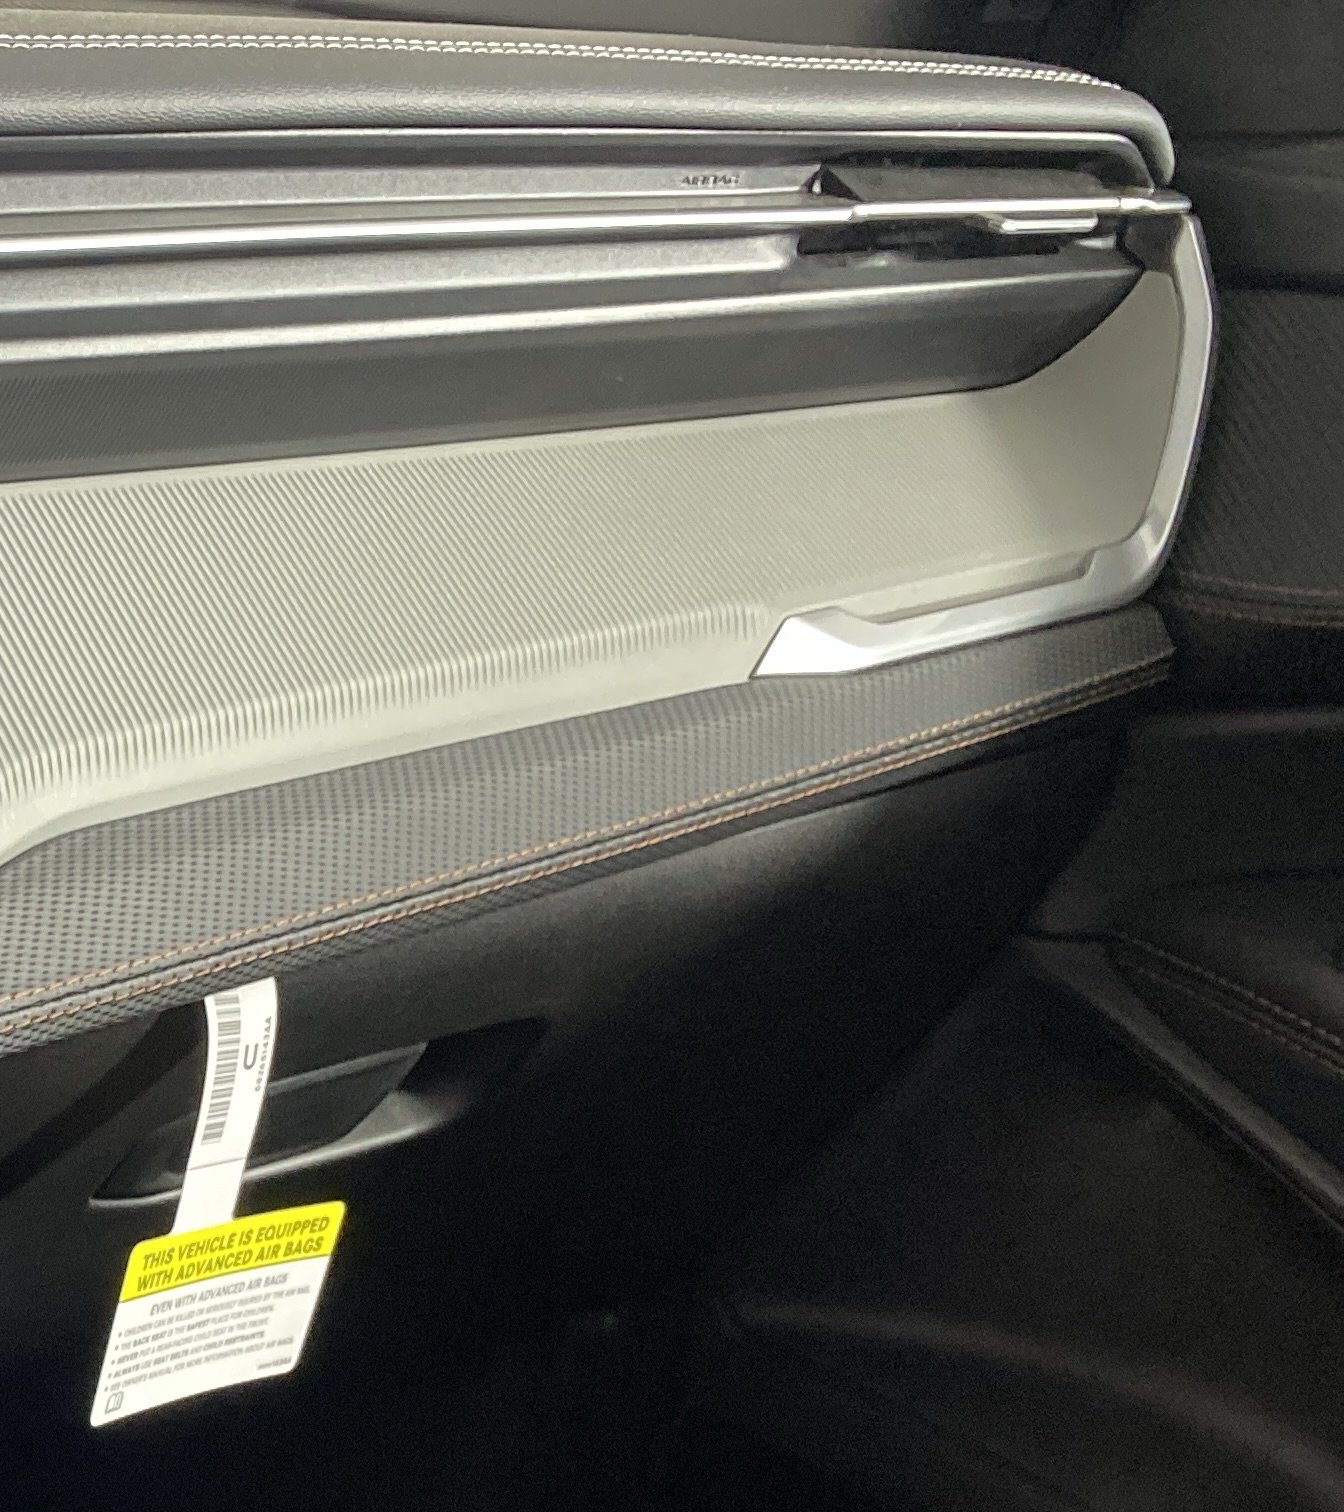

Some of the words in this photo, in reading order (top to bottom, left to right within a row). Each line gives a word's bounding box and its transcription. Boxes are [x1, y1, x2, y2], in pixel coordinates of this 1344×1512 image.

[137, 1270, 173, 1293] WITH
[175, 1251, 253, 1282] ADVANCED
[255, 1246, 281, 1264] AIR
[283, 1236, 324, 1258] BAGS
[143, 1248, 175, 1271] THIS
[178, 1233, 237, 1260] VEHICLE
[238, 1228, 254, 1247] IS
[256, 1216, 330, 1244] EQUIPPED
[150, 1299, 173, 1316] EVEN
[175, 1293, 197, 1309] WITH
[198, 1281, 245, 1303] ADVANCED
[247, 1277, 262, 1291] AIR
